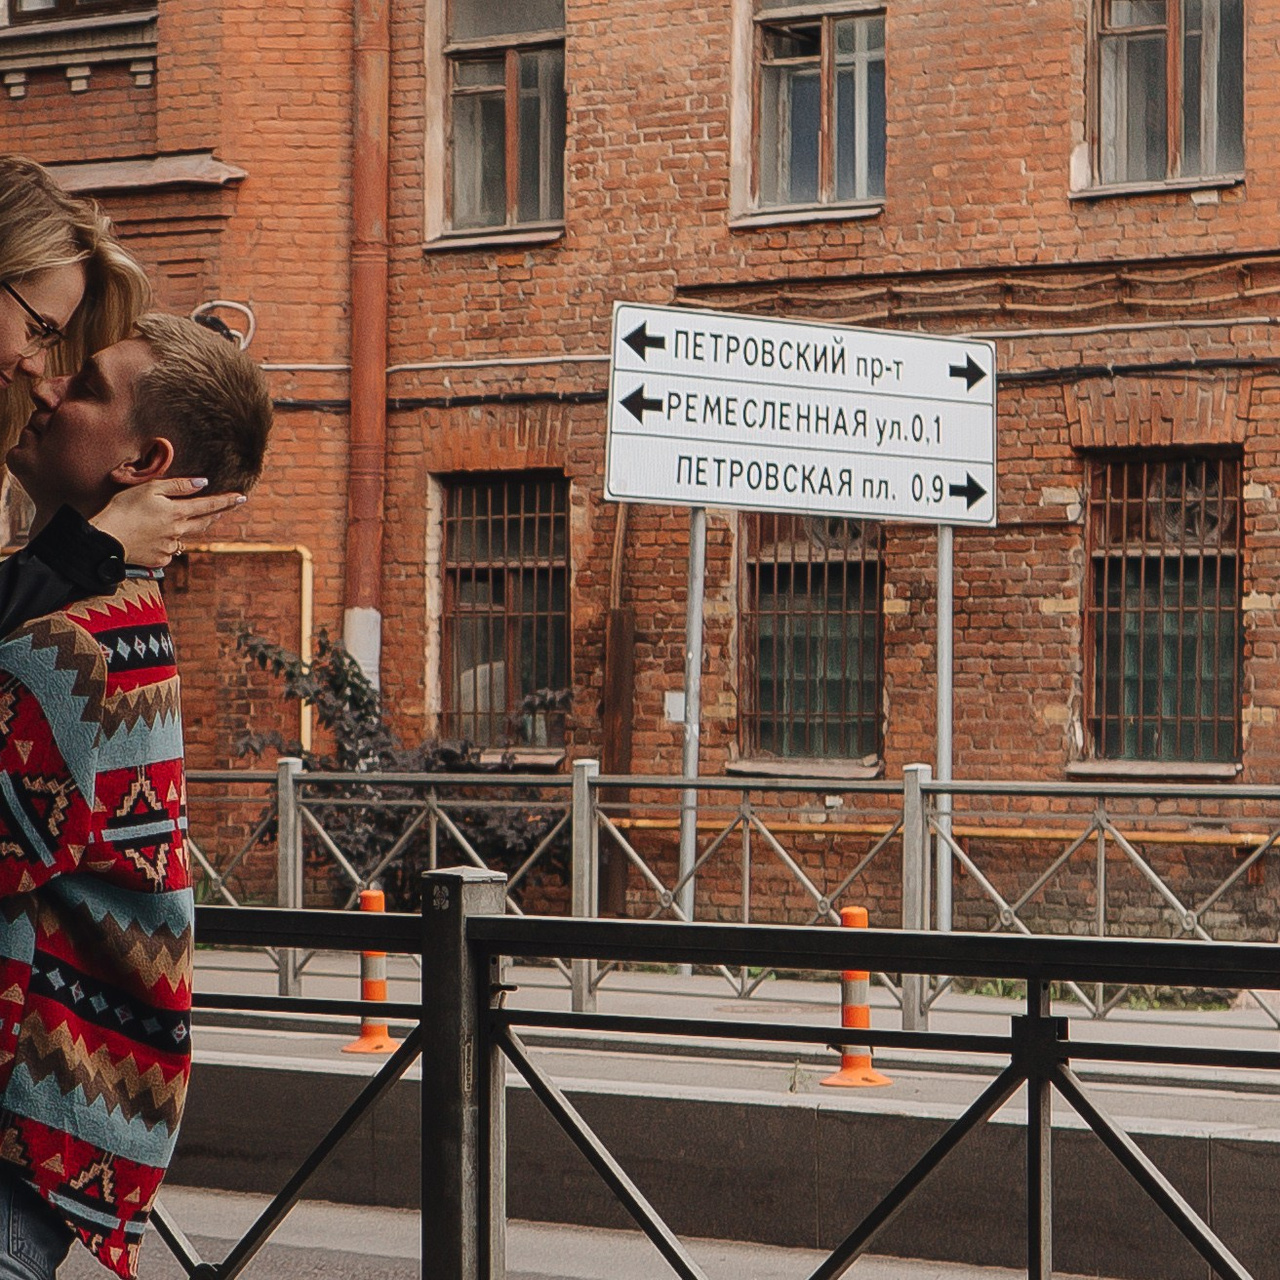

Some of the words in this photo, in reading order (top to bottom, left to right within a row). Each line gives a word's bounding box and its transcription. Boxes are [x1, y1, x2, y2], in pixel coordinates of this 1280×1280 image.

[674, 329, 846, 375] ПЕТРОВСКИЙ
[856, 355, 904, 386] пр-т
[667, 391, 867, 438] РЕМЕСЛЕННАЯ
[676, 455, 852, 497] ПЕТРОВСКАЯ
[862, 477, 896, 500] пл.
[911, 473, 944, 505] 0,9
